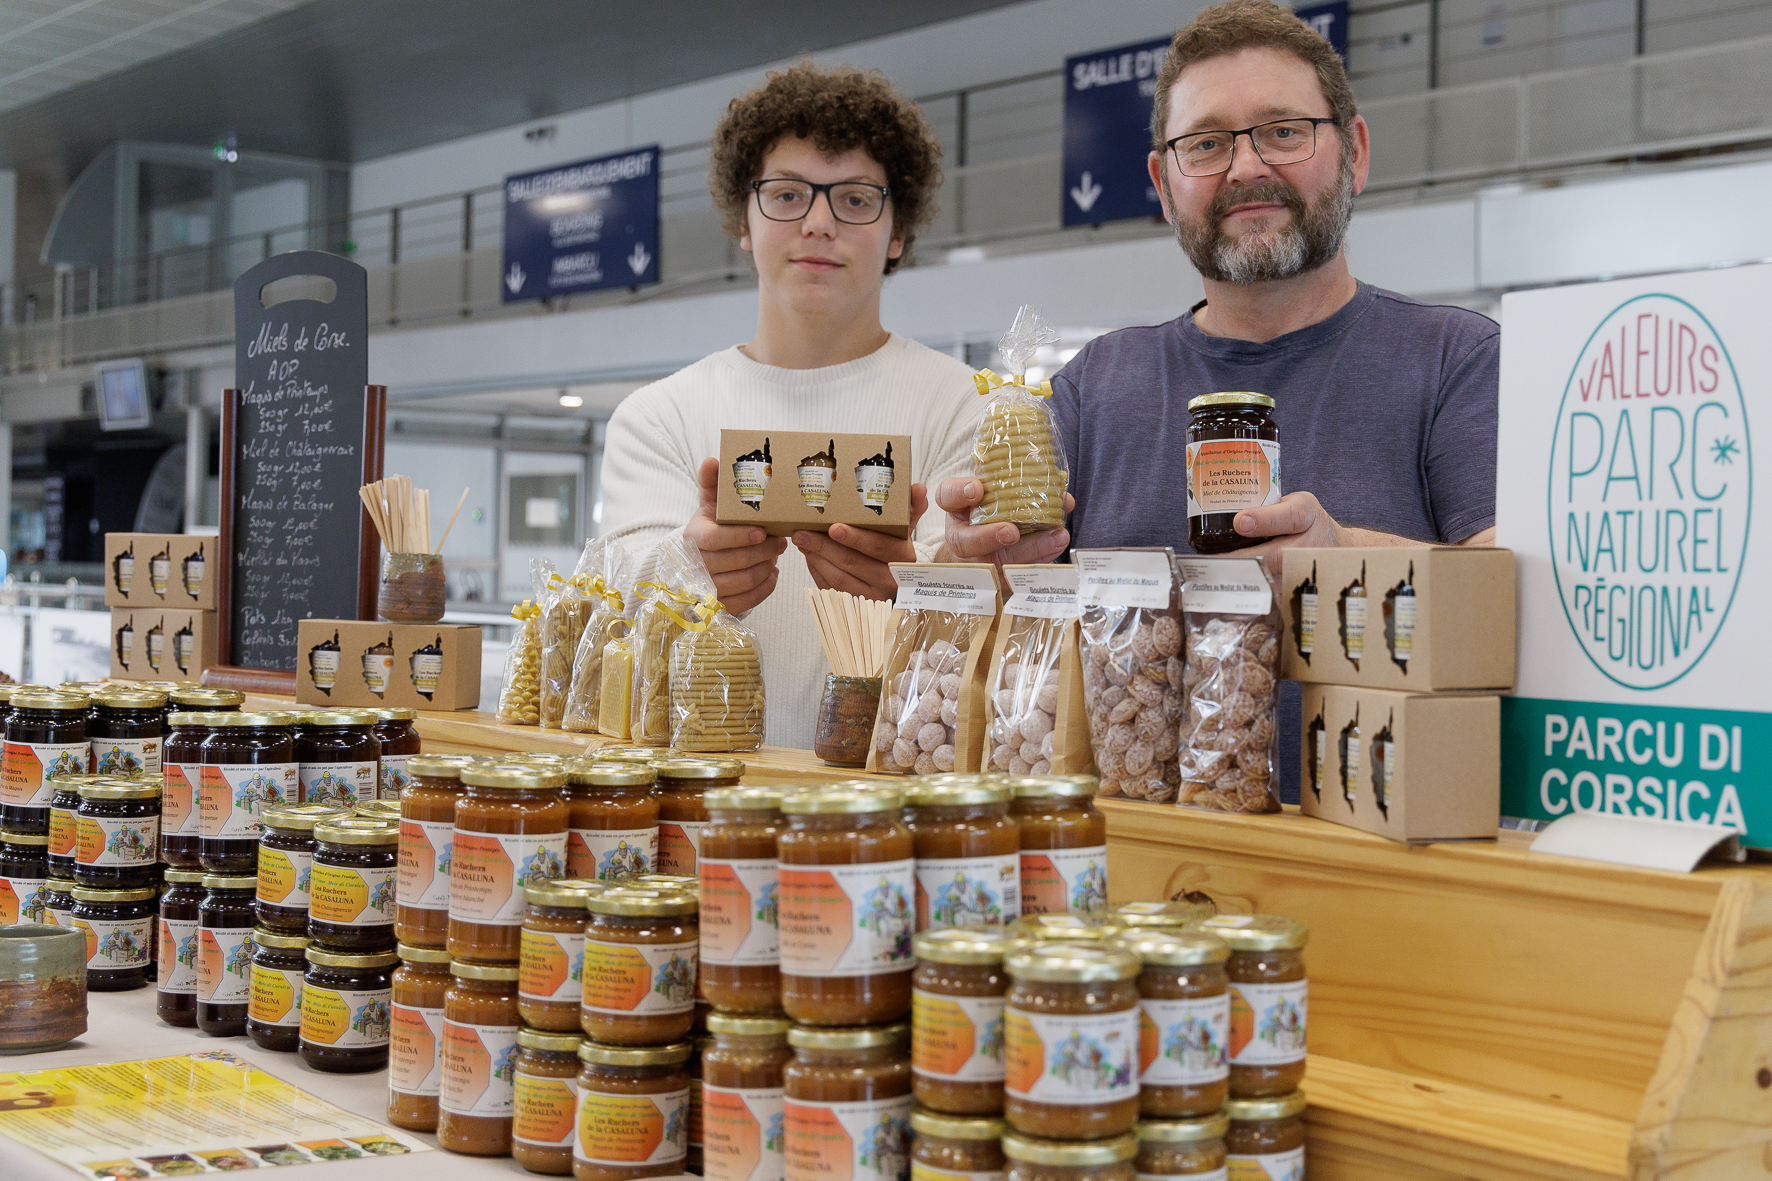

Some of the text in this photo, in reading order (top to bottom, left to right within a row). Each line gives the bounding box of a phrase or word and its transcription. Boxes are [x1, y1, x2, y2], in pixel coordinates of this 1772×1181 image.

[1072, 53, 1132, 91] SALLE
[248, 321, 289, 358] Miels
[294, 327, 309, 352] de
[1580, 313, 1719, 402] VALEURS
[274, 385, 285, 401] de
[242, 438, 268, 460] Miel
[269, 440, 280, 458] de
[1569, 402, 1729, 503] PARC
[1219, 478, 1259, 486] CASALUNA
[1567, 508, 1729, 573] NATUREL
[1133, 577, 1140, 585] du
[1141, 578, 1159, 586] Maquis
[914, 588, 938, 596] Maquis
[947, 589, 977, 599] Printemps
[1575, 578, 1714, 670] RÉGIONAL
[1544, 714, 1742, 773] PARCU DI
[1540, 768, 1748, 835] CORSICA
[459, 861, 486, 872] Ruchers
[456, 870, 495, 883] CASALUNA
[322, 886, 347, 896] Ruchers
[320, 894, 354, 905] CASALUNA
[607, 1117, 640, 1126] Ruchers
[603, 1125, 649, 1135] CASALUNA
